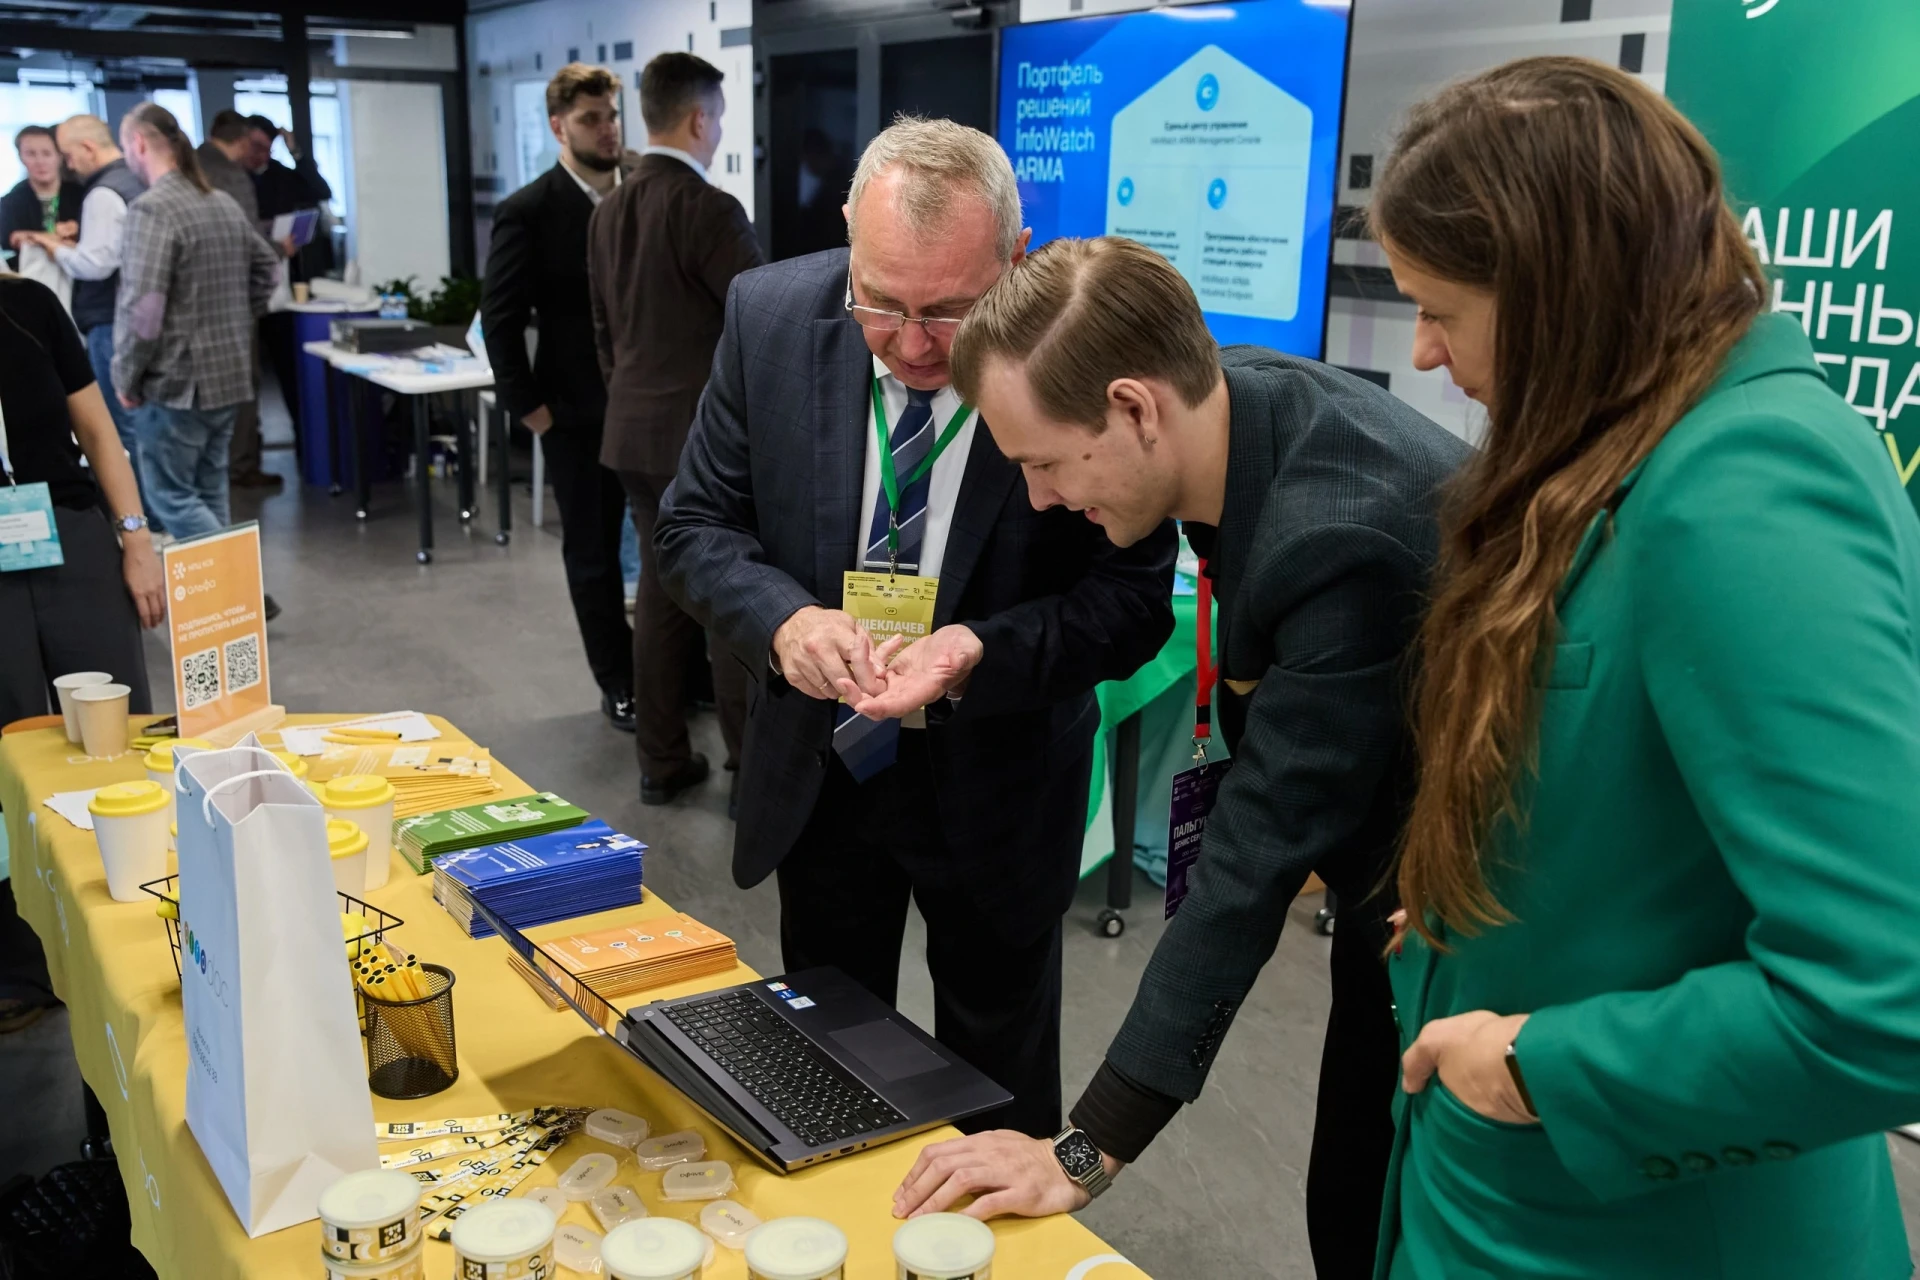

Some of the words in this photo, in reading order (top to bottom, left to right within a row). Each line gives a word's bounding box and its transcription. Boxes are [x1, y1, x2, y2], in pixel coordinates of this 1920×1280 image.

[1018, 59, 1104, 94] Портфель
[1016, 90, 1092, 125] решений
[1015, 125, 1096, 152] InfoWatch
[1015, 155, 1065, 183] ARMA
[1741, 206, 1894, 271] АШИ
[1771, 278, 1920, 348] ННЫ
[1173, 815, 1207, 839] ПАЛЬГУ
